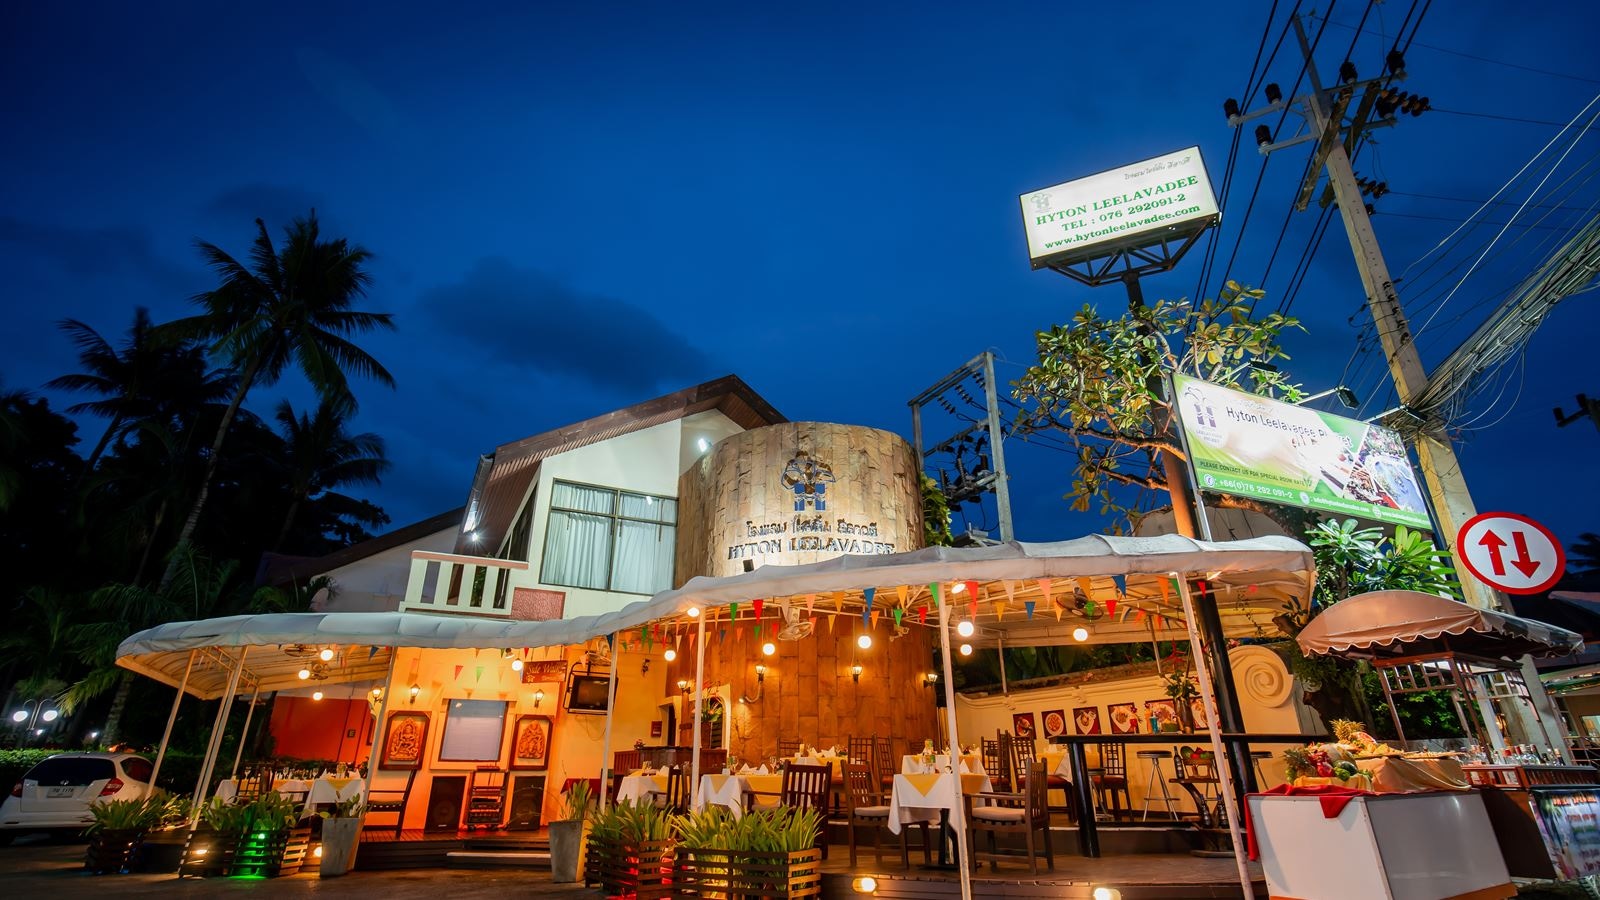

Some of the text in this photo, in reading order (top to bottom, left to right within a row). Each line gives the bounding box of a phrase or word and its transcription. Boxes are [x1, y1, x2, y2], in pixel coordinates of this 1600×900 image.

[1035, 175, 1198, 226] HYTON LEELAVADEE
[1062, 218, 1088, 232] TEL
[1099, 210, 1124, 222] 076
[1128, 193, 1186, 215] 292091-2
[1045, 204, 1201, 249] www.hytonleelavadee.com
[1226, 406, 1258, 424] Hyton
[1200, 461, 1218, 470] PLEASE
[1220, 464, 1241, 474] CONTACT
[1256, 484, 1272, 494] 292
[728, 536, 897, 560] HYTON LEELAVADEE
